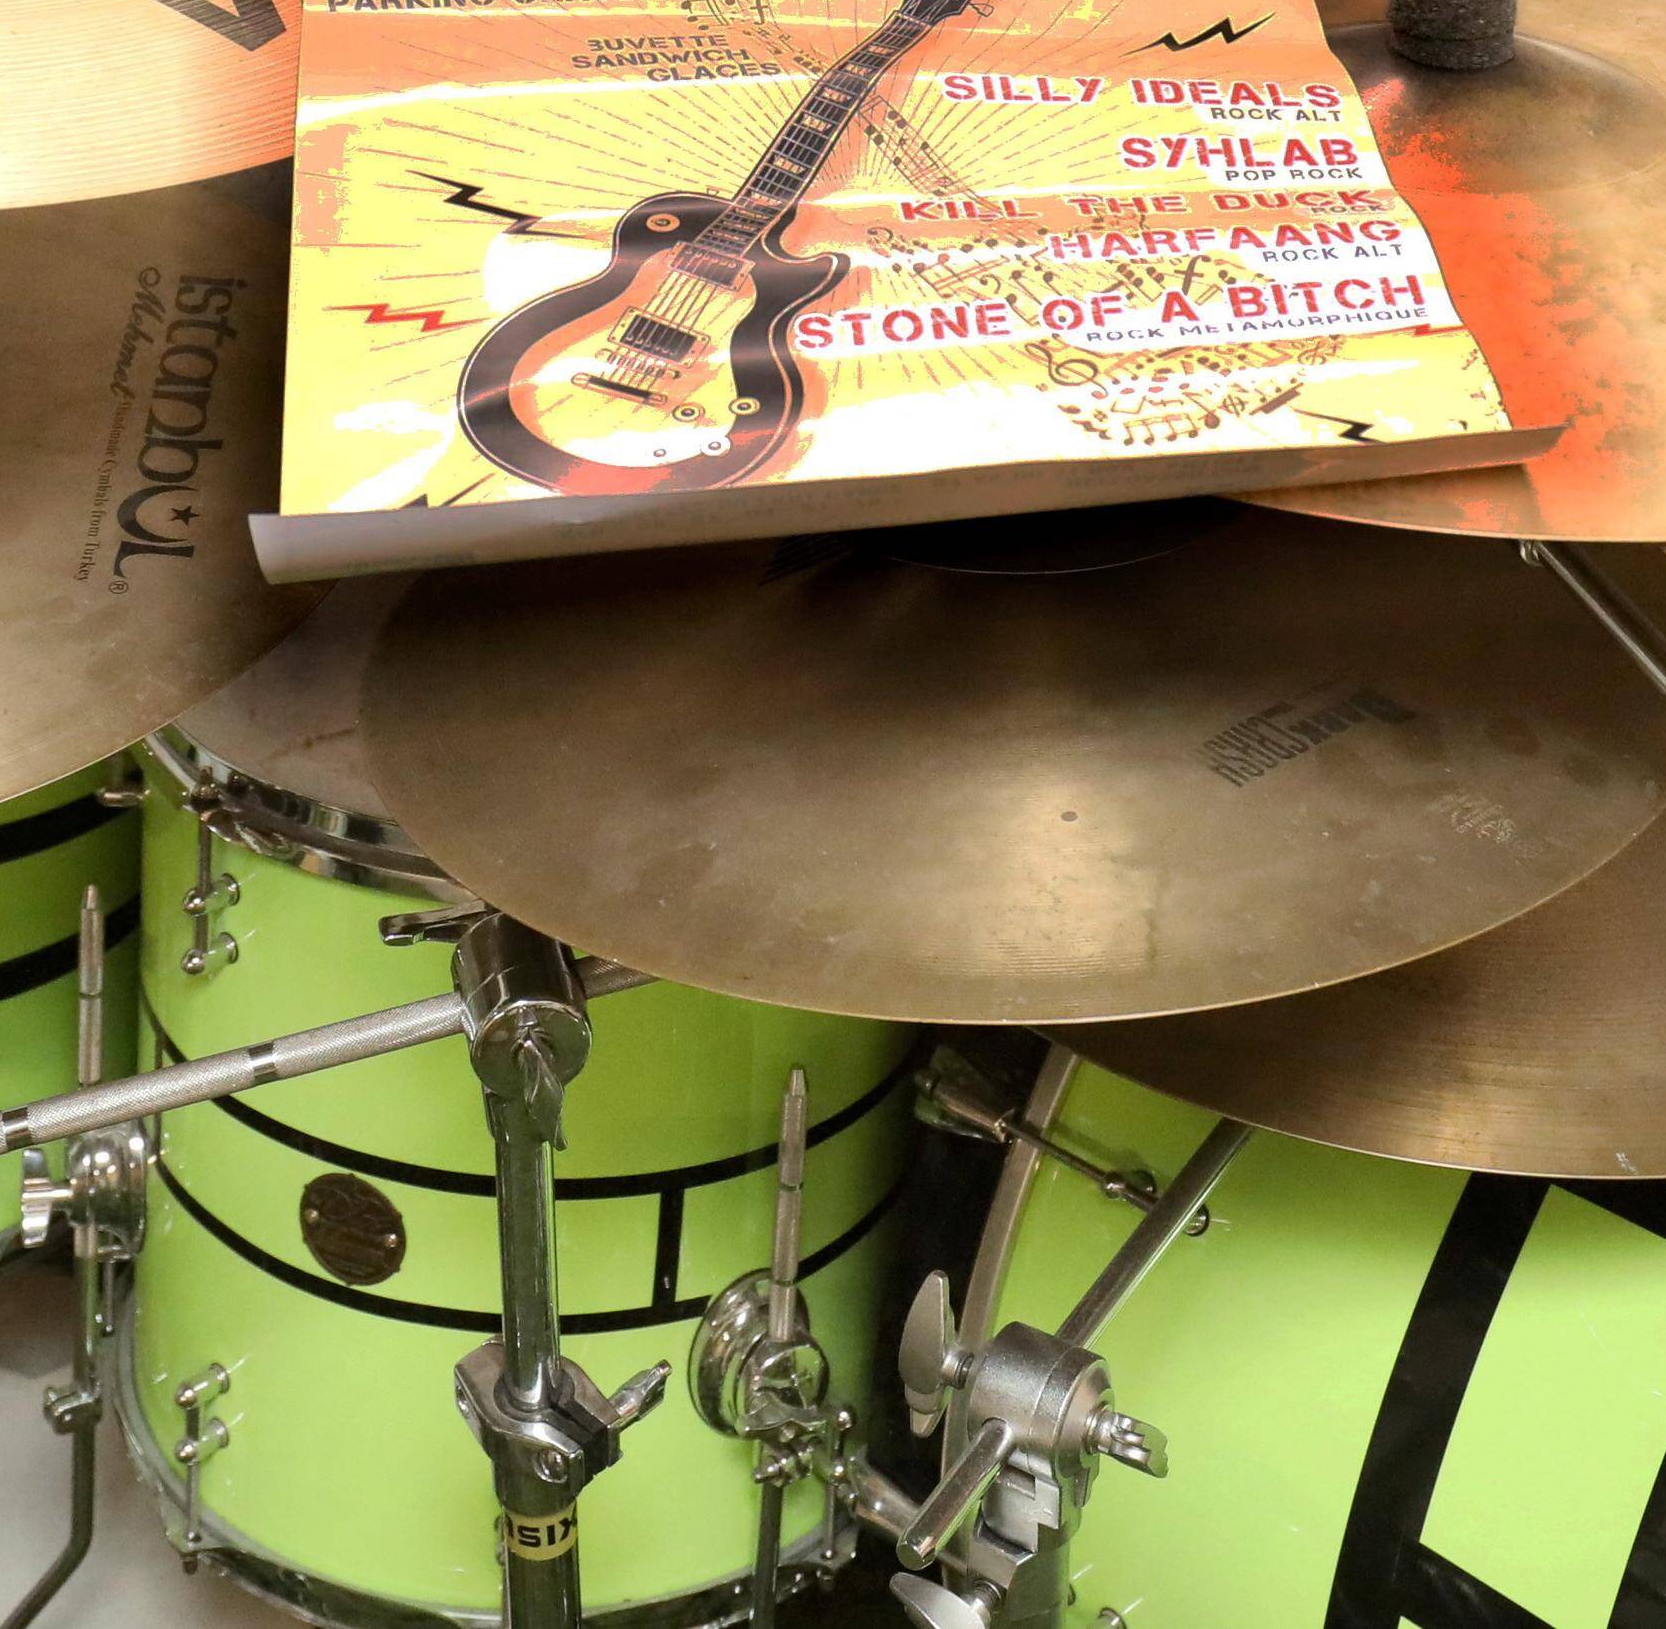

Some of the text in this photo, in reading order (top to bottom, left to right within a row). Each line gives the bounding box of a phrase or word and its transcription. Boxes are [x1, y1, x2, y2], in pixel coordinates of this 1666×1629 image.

[587, 33, 728, 51] BUVETTE
[571, 47, 751, 70] SANDWICH
[646, 62, 782, 83] GLACES
[944, 74, 1342, 108] SILLY IDEALS
[1211, 107, 1342, 123] ROCK ALT
[1121, 136, 1359, 169] SYHLAB
[1226, 166, 1363, 182] POP ROCK
[900, 189, 1384, 221] KILL THE DUCK
[1310, 204, 1386, 215] ROCK
[1050, 220, 1402, 260] HARFAANG
[1262, 243, 1405, 263] ROCK ALT
[799, 274, 1427, 349] STONE OF A BITCH
[110, 267, 167, 399] Mehmet
[1086, 327, 1163, 343] ROCK
